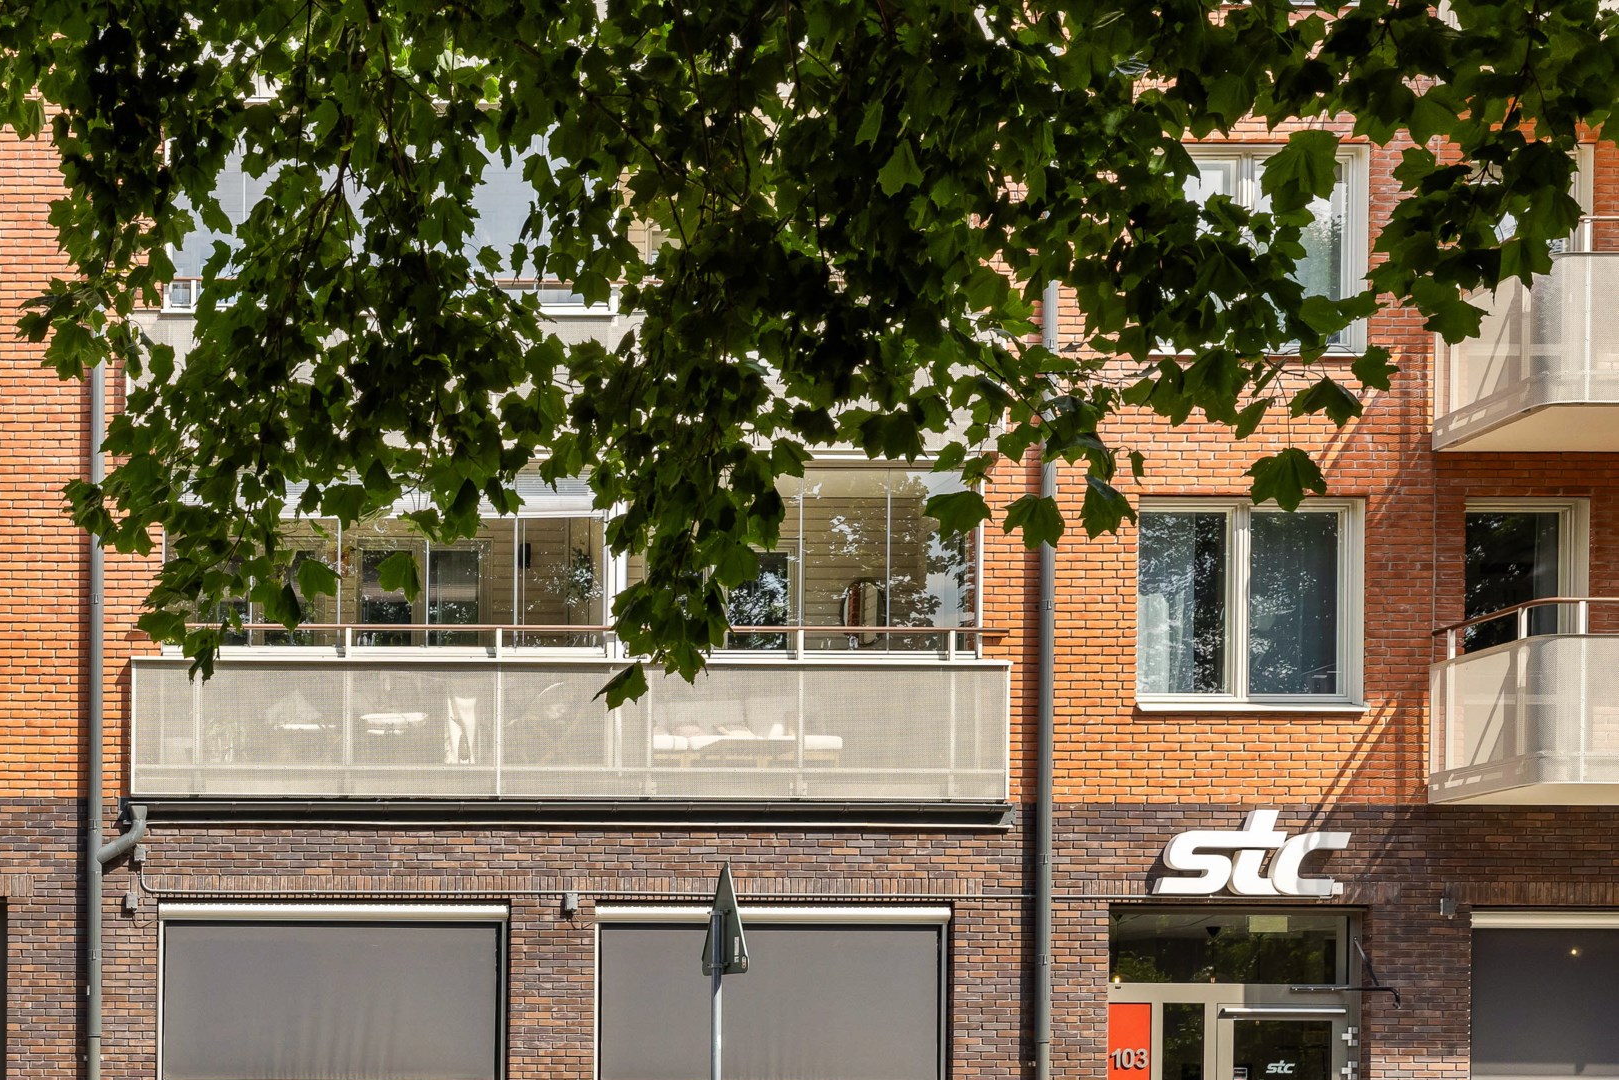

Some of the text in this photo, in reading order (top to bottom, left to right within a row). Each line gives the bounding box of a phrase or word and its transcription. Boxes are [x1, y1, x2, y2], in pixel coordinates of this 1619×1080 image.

[1152, 809, 1352, 896] stc
[1111, 1048, 1149, 1069] 103
[1265, 1060, 1295, 1074] stc
